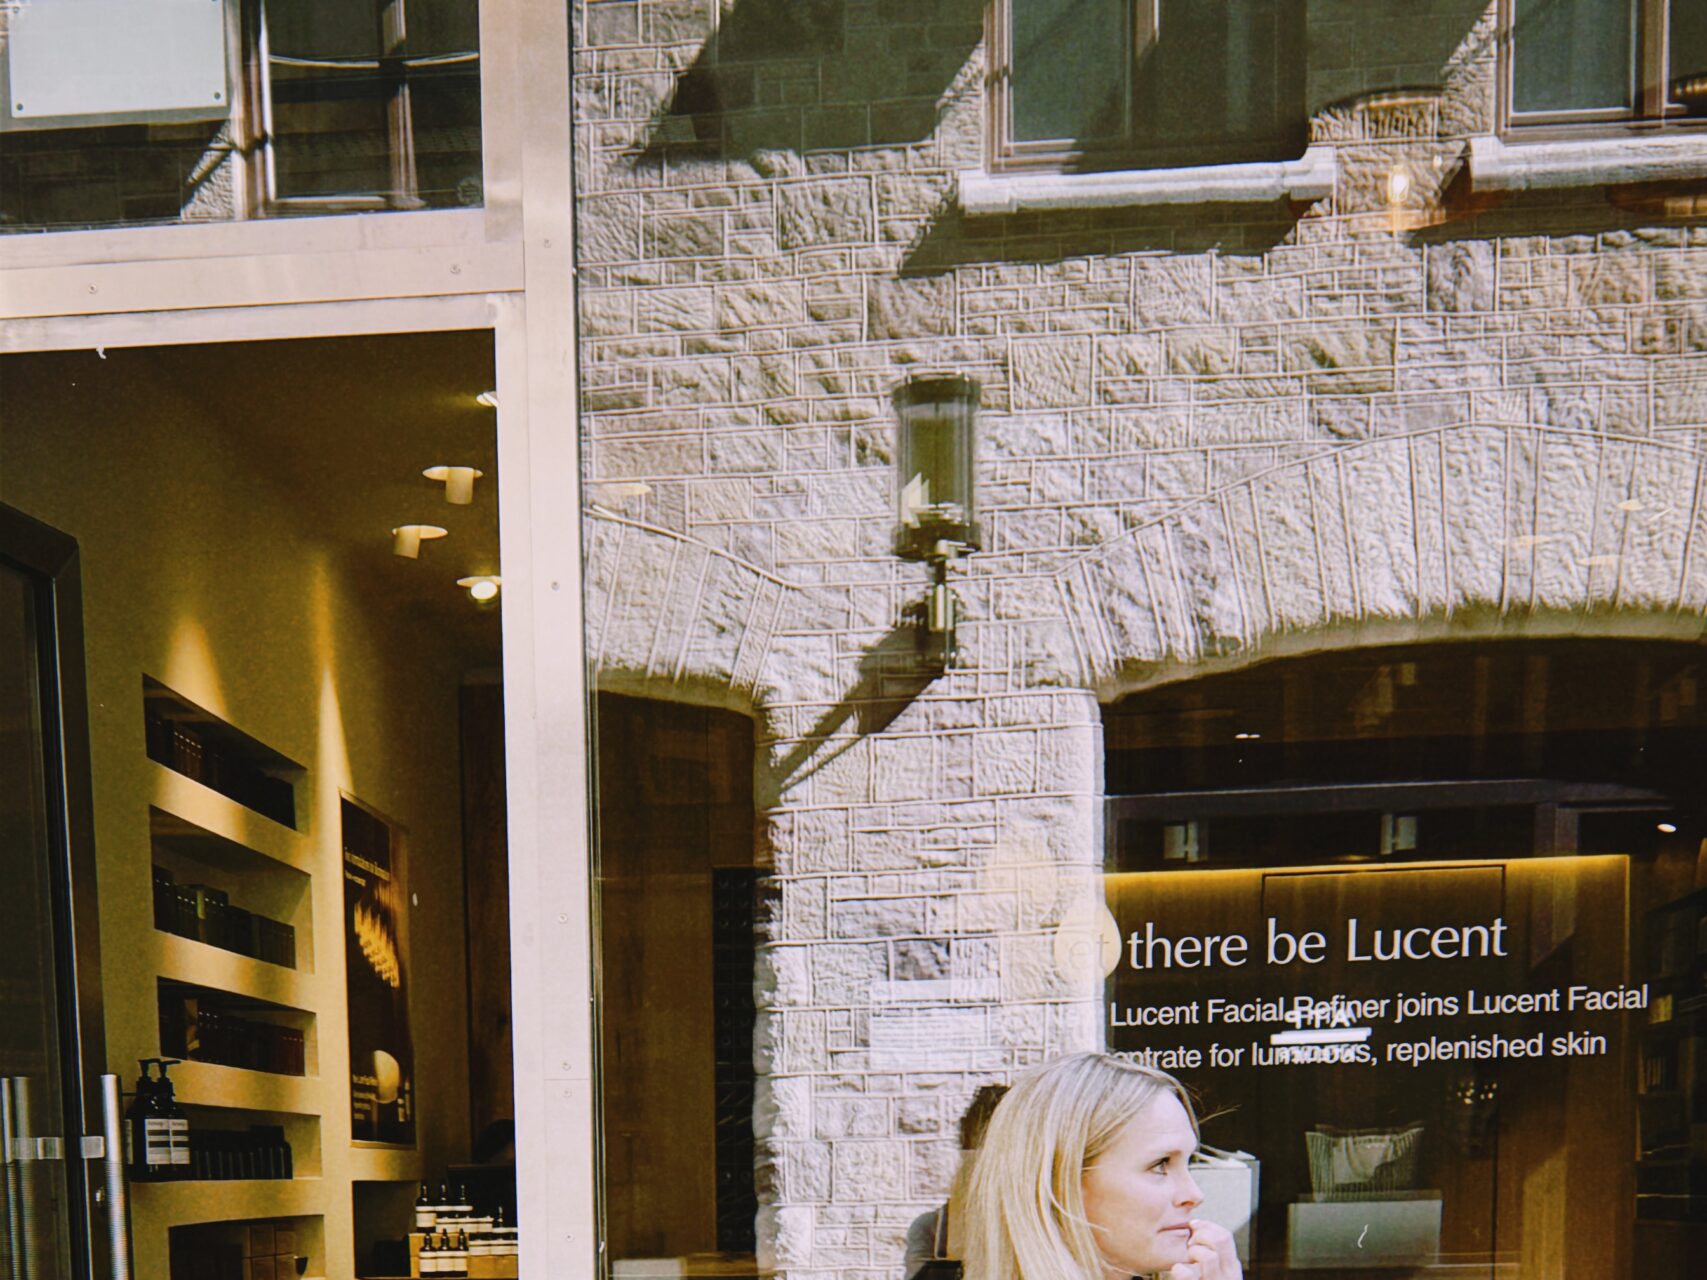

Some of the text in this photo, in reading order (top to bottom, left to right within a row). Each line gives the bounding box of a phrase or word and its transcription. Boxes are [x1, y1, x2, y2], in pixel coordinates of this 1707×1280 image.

[1126, 922, 1249, 970] there
[1267, 917, 1327, 965] be
[1347, 917, 1509, 962] Lucent
[1110, 1001, 1200, 1026] Lucent
[1207, 997, 1284, 1023] Facial
[1394, 992, 1460, 1024] joins
[1467, 988, 1560, 1015] Lucent
[1568, 983, 1648, 1011] Facial
[1208, 1043, 1246, 1067] for
[1386, 1032, 1544, 1068] replenished
[1550, 1031, 1606, 1057] skin
